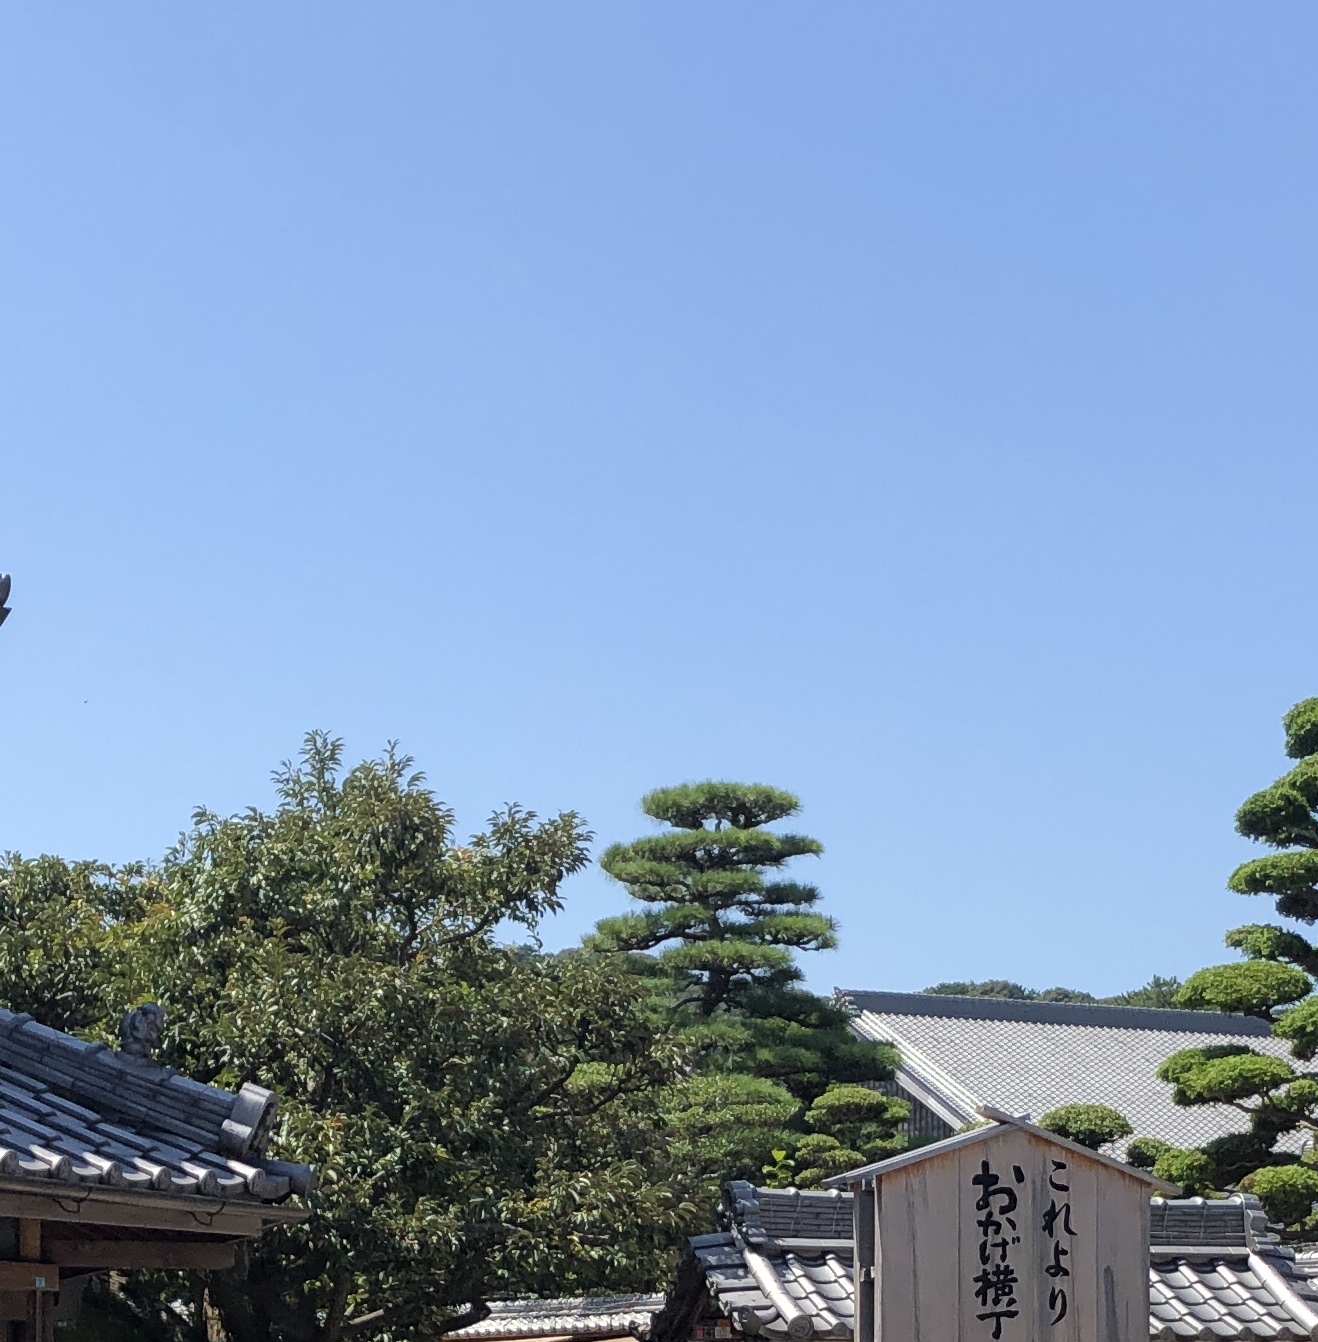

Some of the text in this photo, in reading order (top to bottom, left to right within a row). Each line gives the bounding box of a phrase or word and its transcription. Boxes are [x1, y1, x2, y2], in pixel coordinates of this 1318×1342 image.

[972, 1160, 1025, 1340] おかげ横丁
[1041, 1160, 1077, 1325] これより
